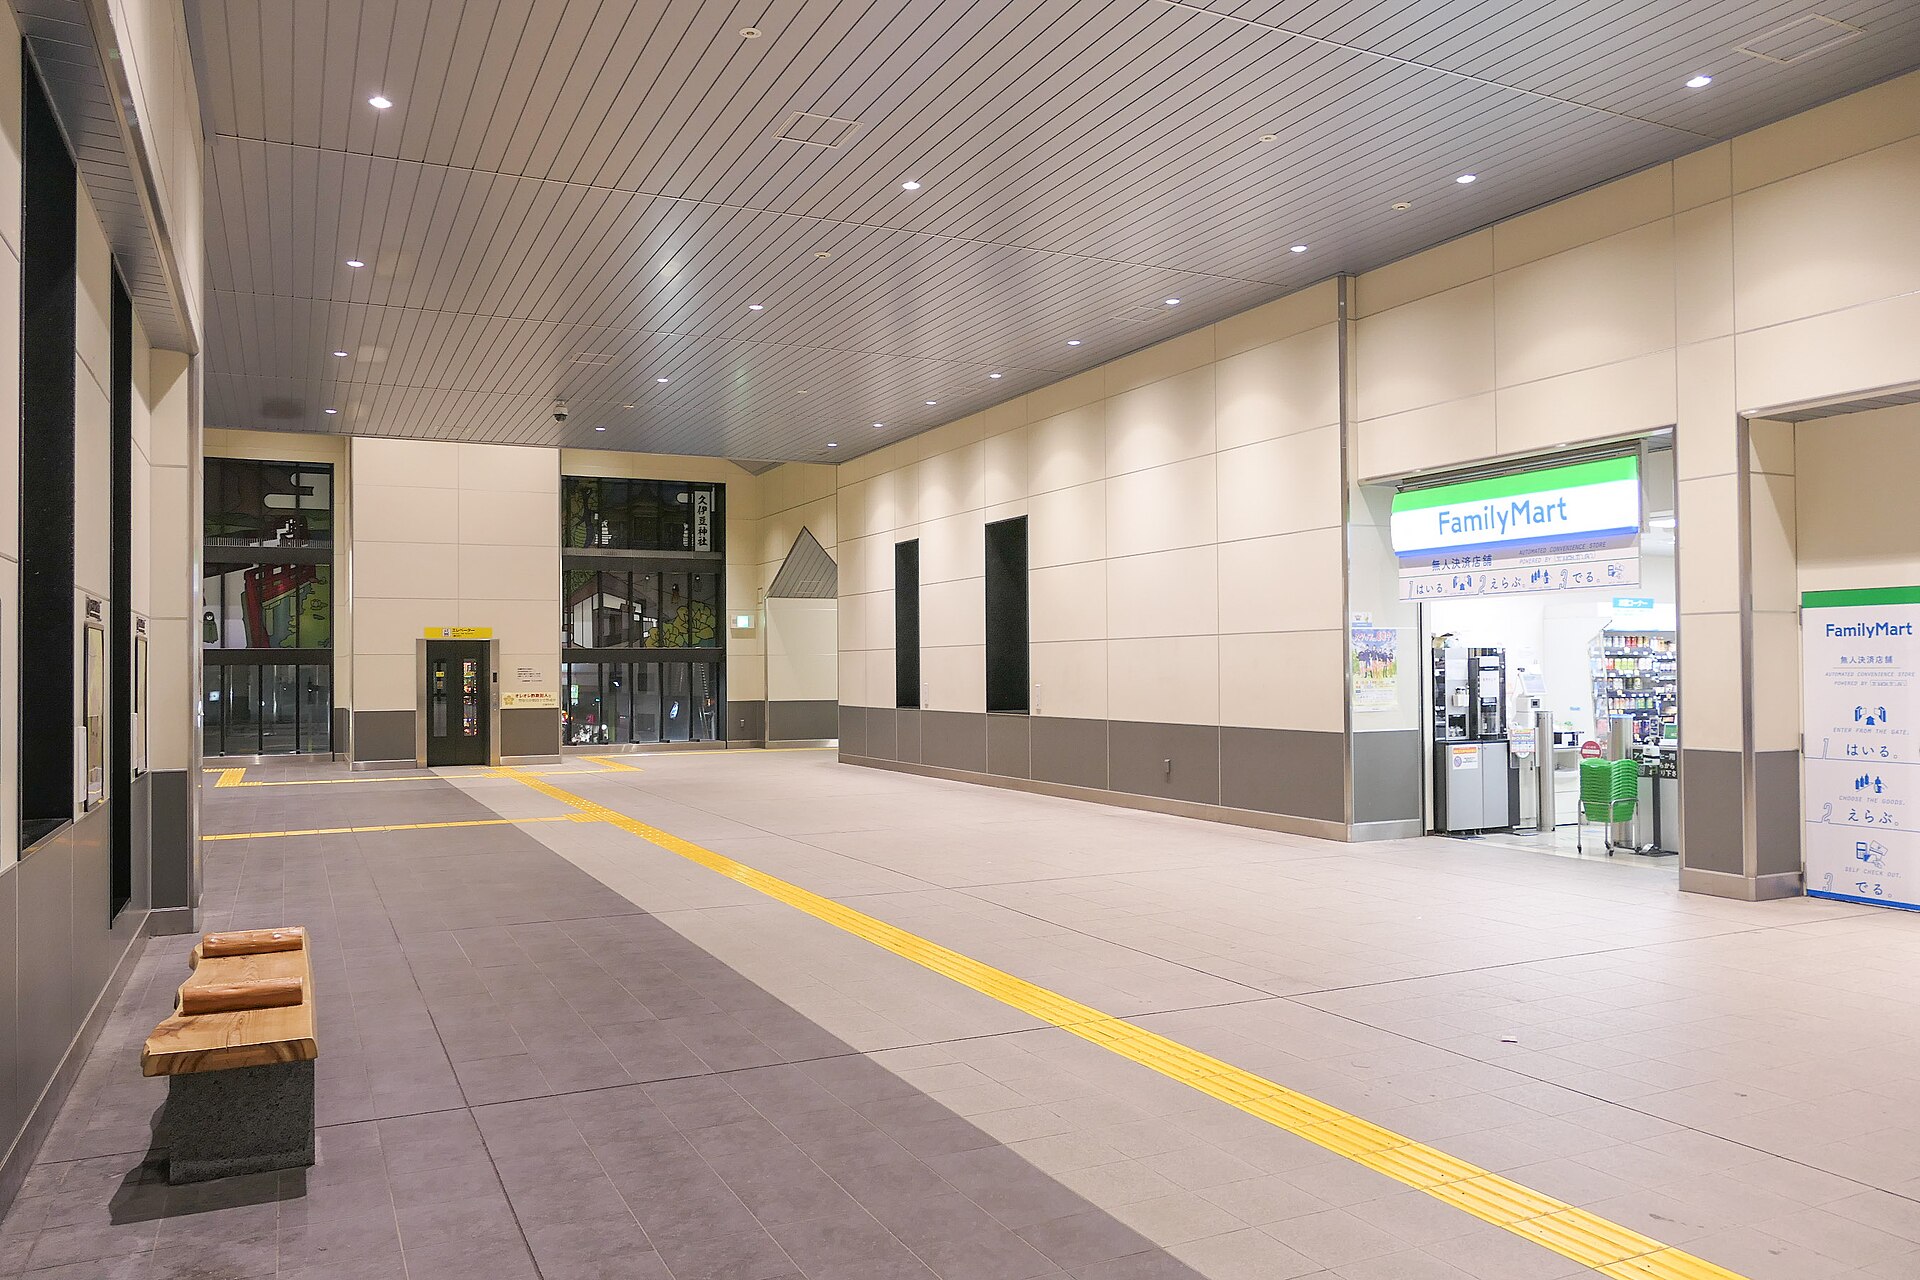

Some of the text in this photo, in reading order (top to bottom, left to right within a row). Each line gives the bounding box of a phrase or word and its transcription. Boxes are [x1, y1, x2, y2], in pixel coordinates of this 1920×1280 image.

[696, 495, 708, 546] 久伊豆神社
[1438, 497, 1568, 536] FamilyMart
[1518, 541, 1607, 556] AUTOMATED CONVENIENCE STORE
[1431, 554, 1494, 571] 無人決済店舗
[1519, 557, 1542, 565] POWERED
[1825, 621, 1913, 639] FamilyMart
[1840, 656, 1893, 665] 無人決済店舗
[1846, 743, 1898, 760] はいる。
[1848, 808, 1900, 827] えらぶ。
[1863, 868, 1884, 876] CHECK
[1855, 881, 1893, 899] でる。
